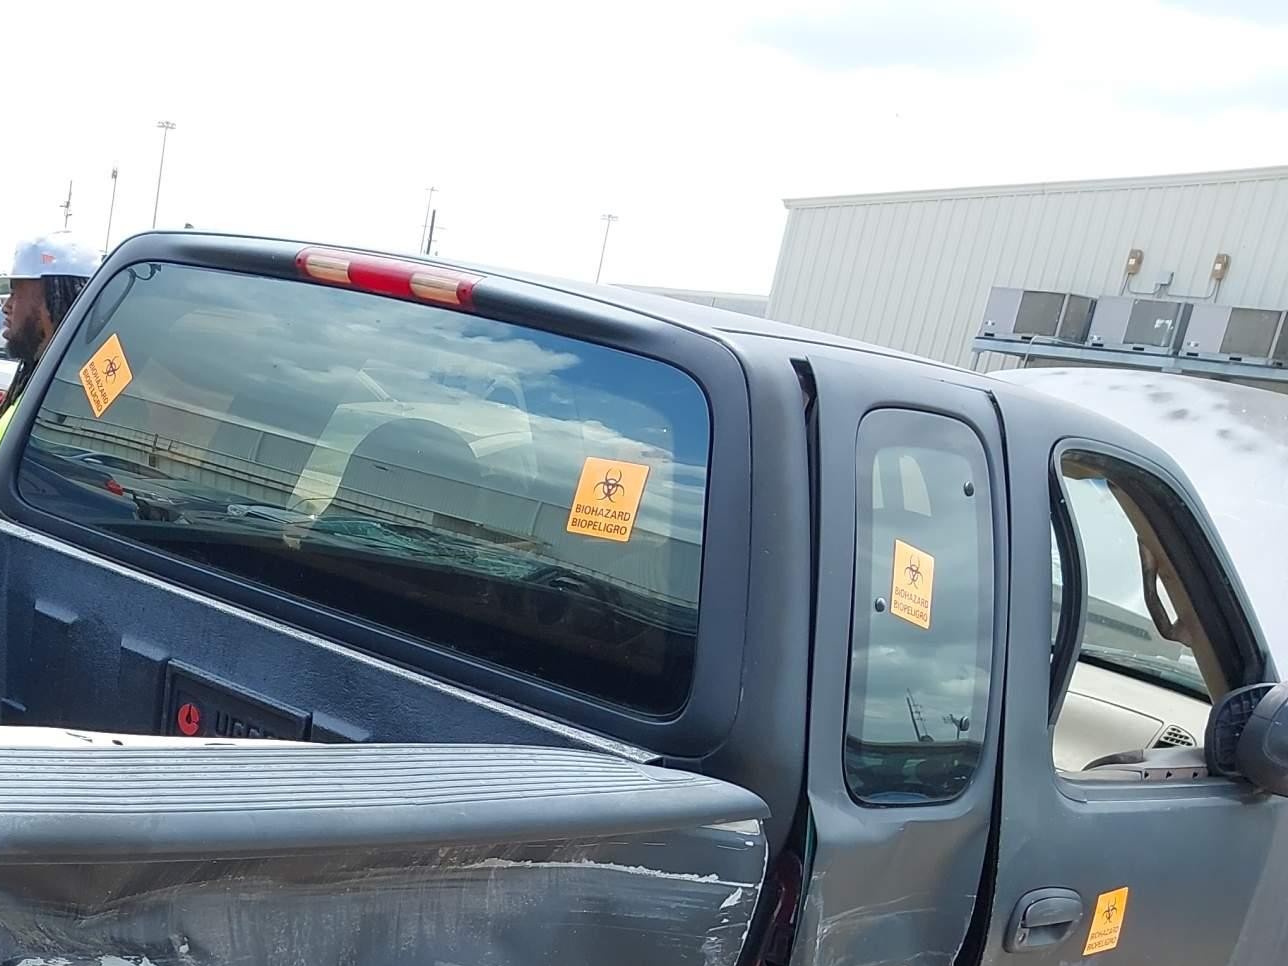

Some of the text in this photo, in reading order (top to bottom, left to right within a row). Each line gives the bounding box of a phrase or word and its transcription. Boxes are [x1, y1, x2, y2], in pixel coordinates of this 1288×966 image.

[82, 368, 103, 412] BIOPELIGRO
[89, 361, 109, 405] BIOHAZARD
[575, 503, 631, 522] BIOHAZARD
[571, 517, 628, 536] BIOPELIGRO
[894, 586, 929, 609] BIOHAZARD
[893, 599, 928, 622] BIOPELIGRO
